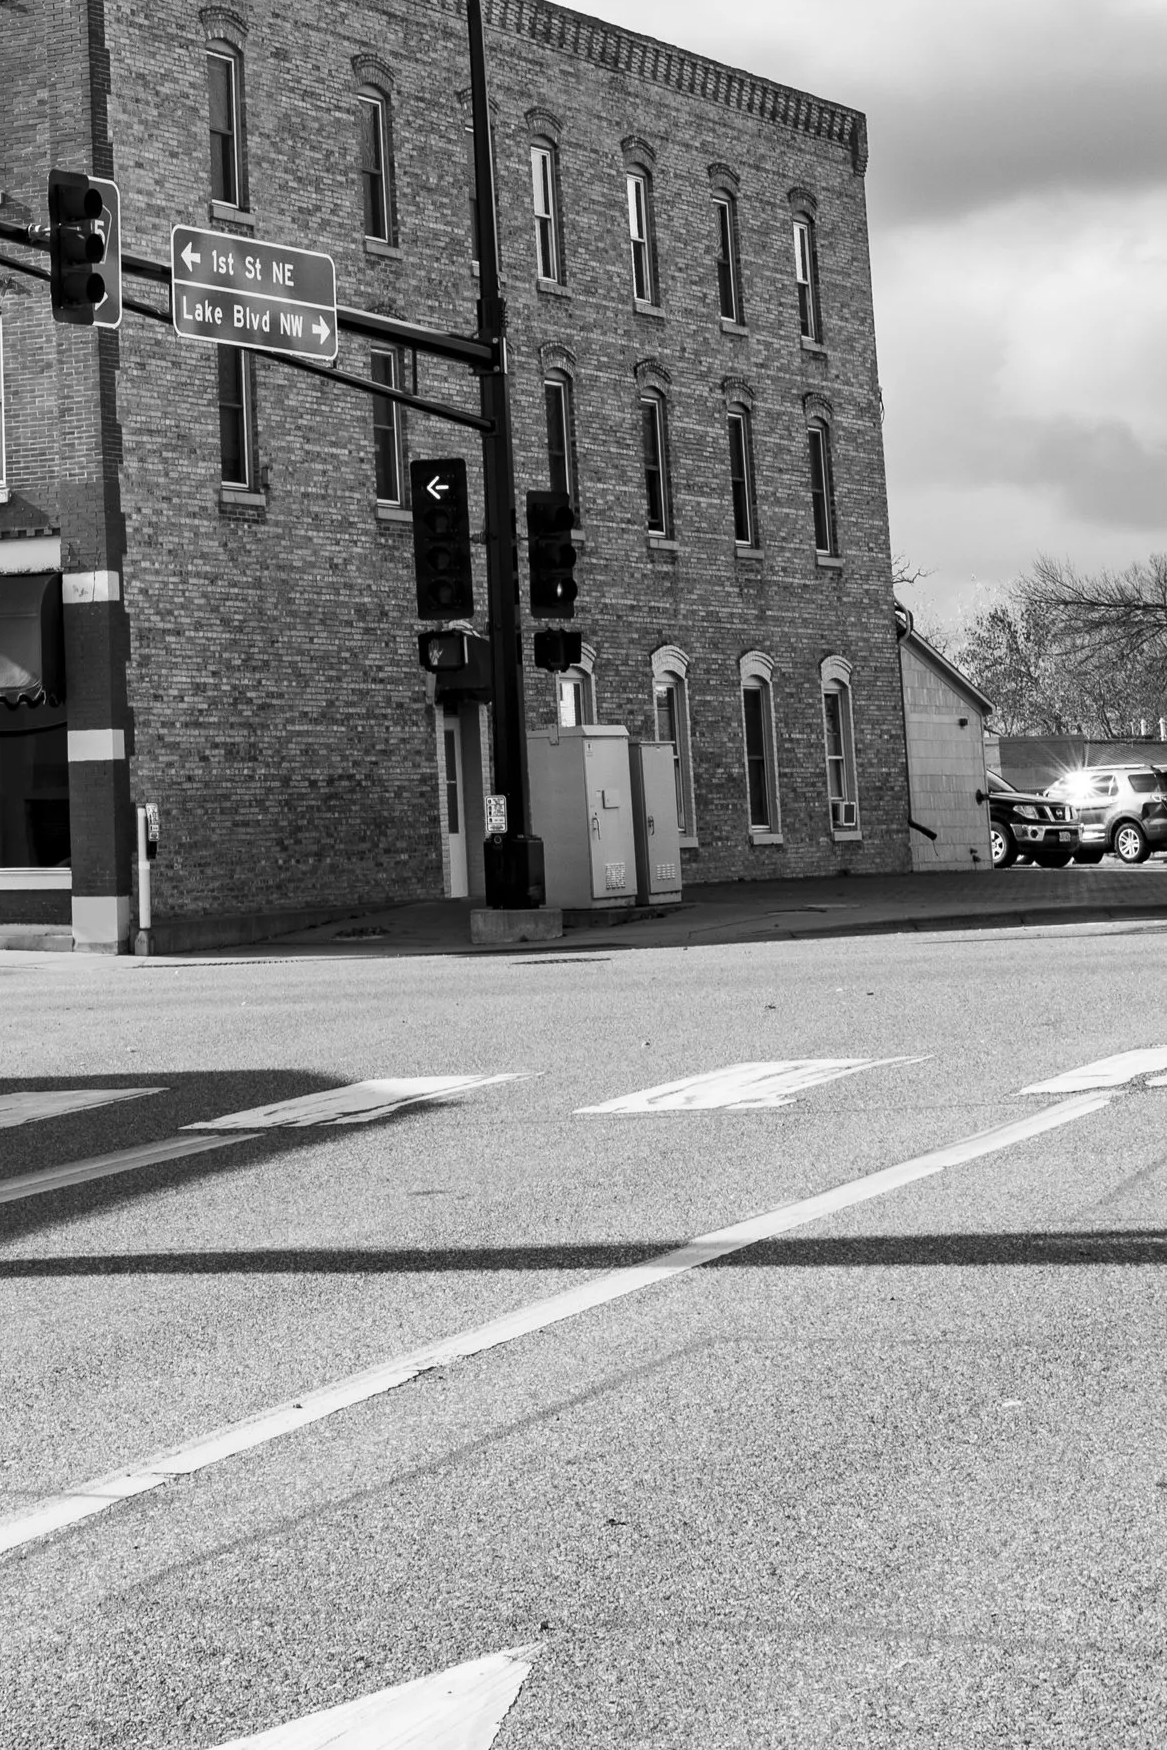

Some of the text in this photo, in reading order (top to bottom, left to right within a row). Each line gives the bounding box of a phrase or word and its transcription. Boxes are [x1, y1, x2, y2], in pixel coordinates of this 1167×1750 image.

[212, 250, 294, 286] 1st St NE
[183, 296, 302, 337] Lake Blvd NW
